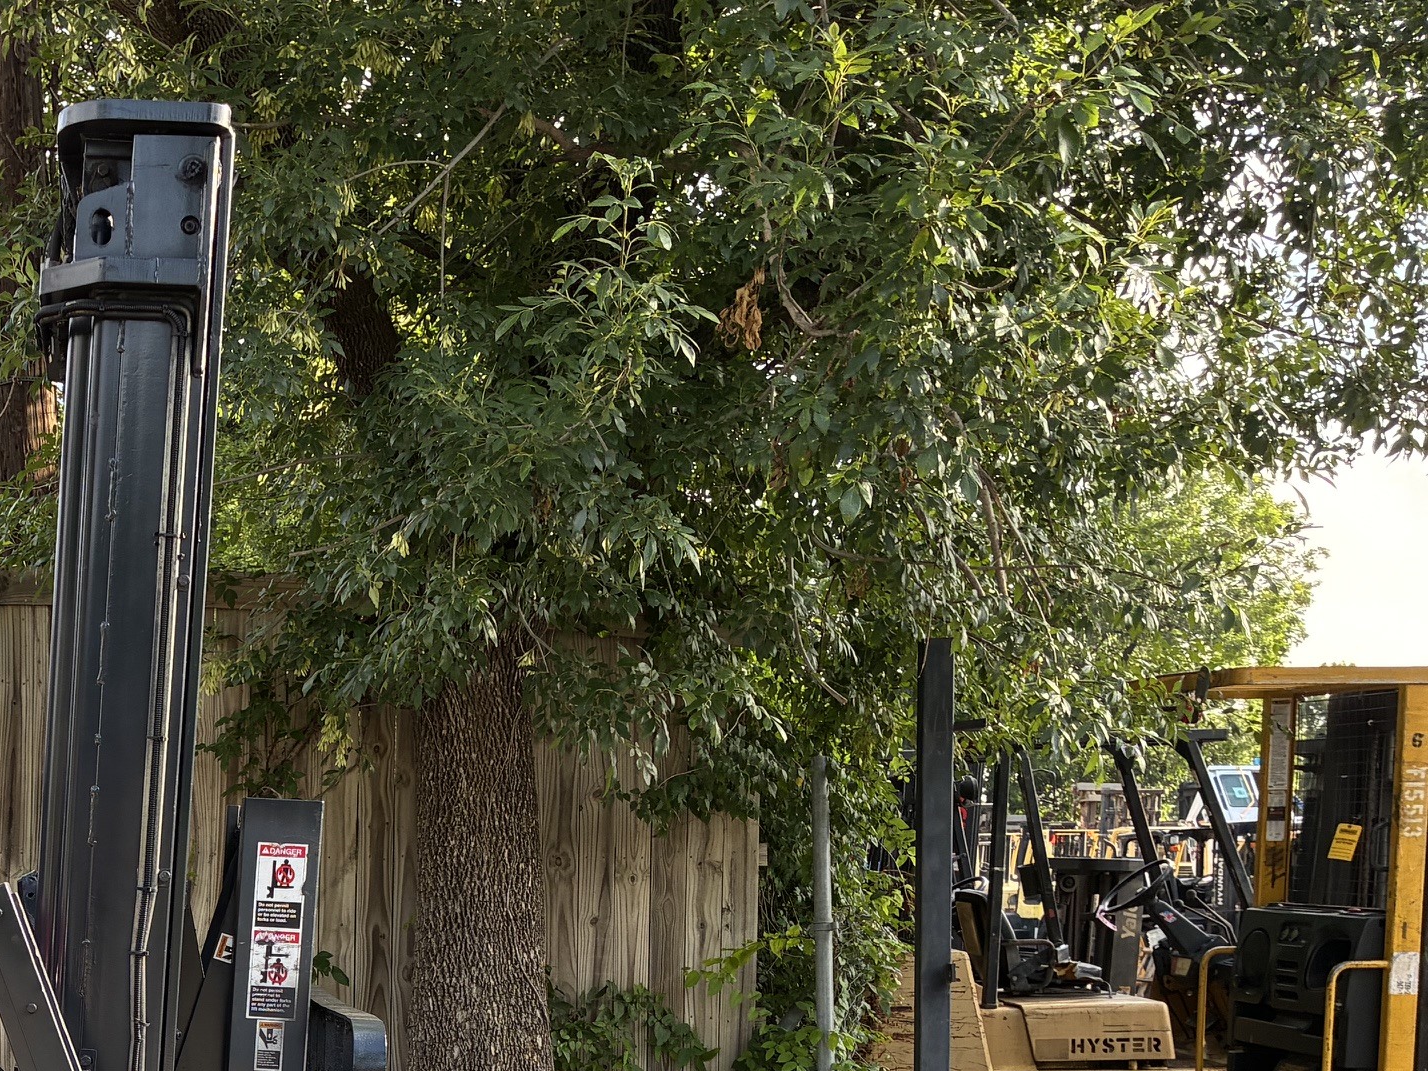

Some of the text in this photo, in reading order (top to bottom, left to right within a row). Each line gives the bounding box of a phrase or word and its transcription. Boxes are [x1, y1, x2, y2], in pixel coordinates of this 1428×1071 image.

[269, 848, 303, 856] DANGER
[1217, 857, 1225, 906] HYUNDAI
[1071, 1037, 1162, 1054] HYSTER
